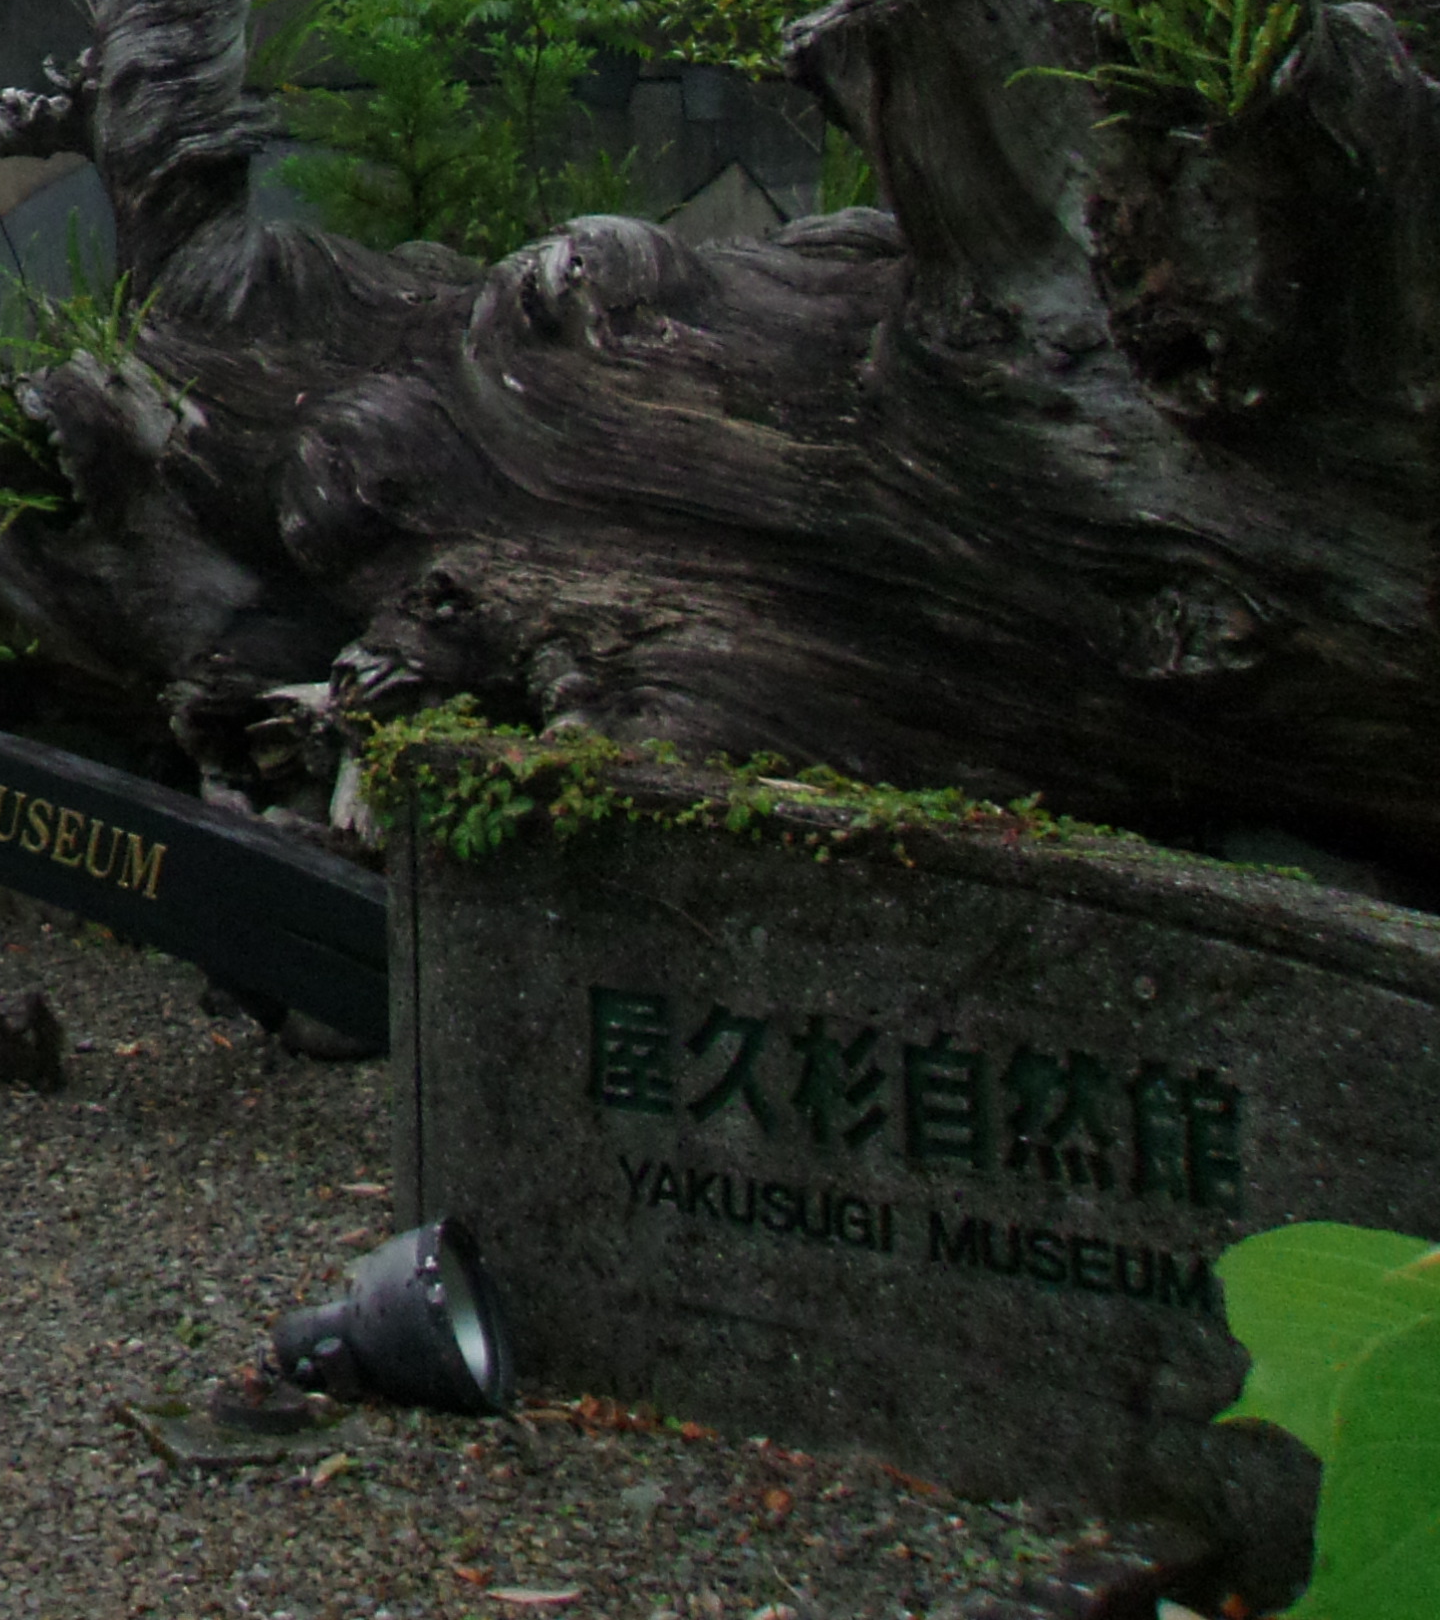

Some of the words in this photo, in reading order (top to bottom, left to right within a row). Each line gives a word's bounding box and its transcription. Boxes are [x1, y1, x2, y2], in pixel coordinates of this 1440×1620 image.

[588, 986, 1242, 1214] 屋久杉自然館
[620, 1155, 894, 1253] YAKUSUGI
[929, 1210, 1216, 1314] MUSEUM
